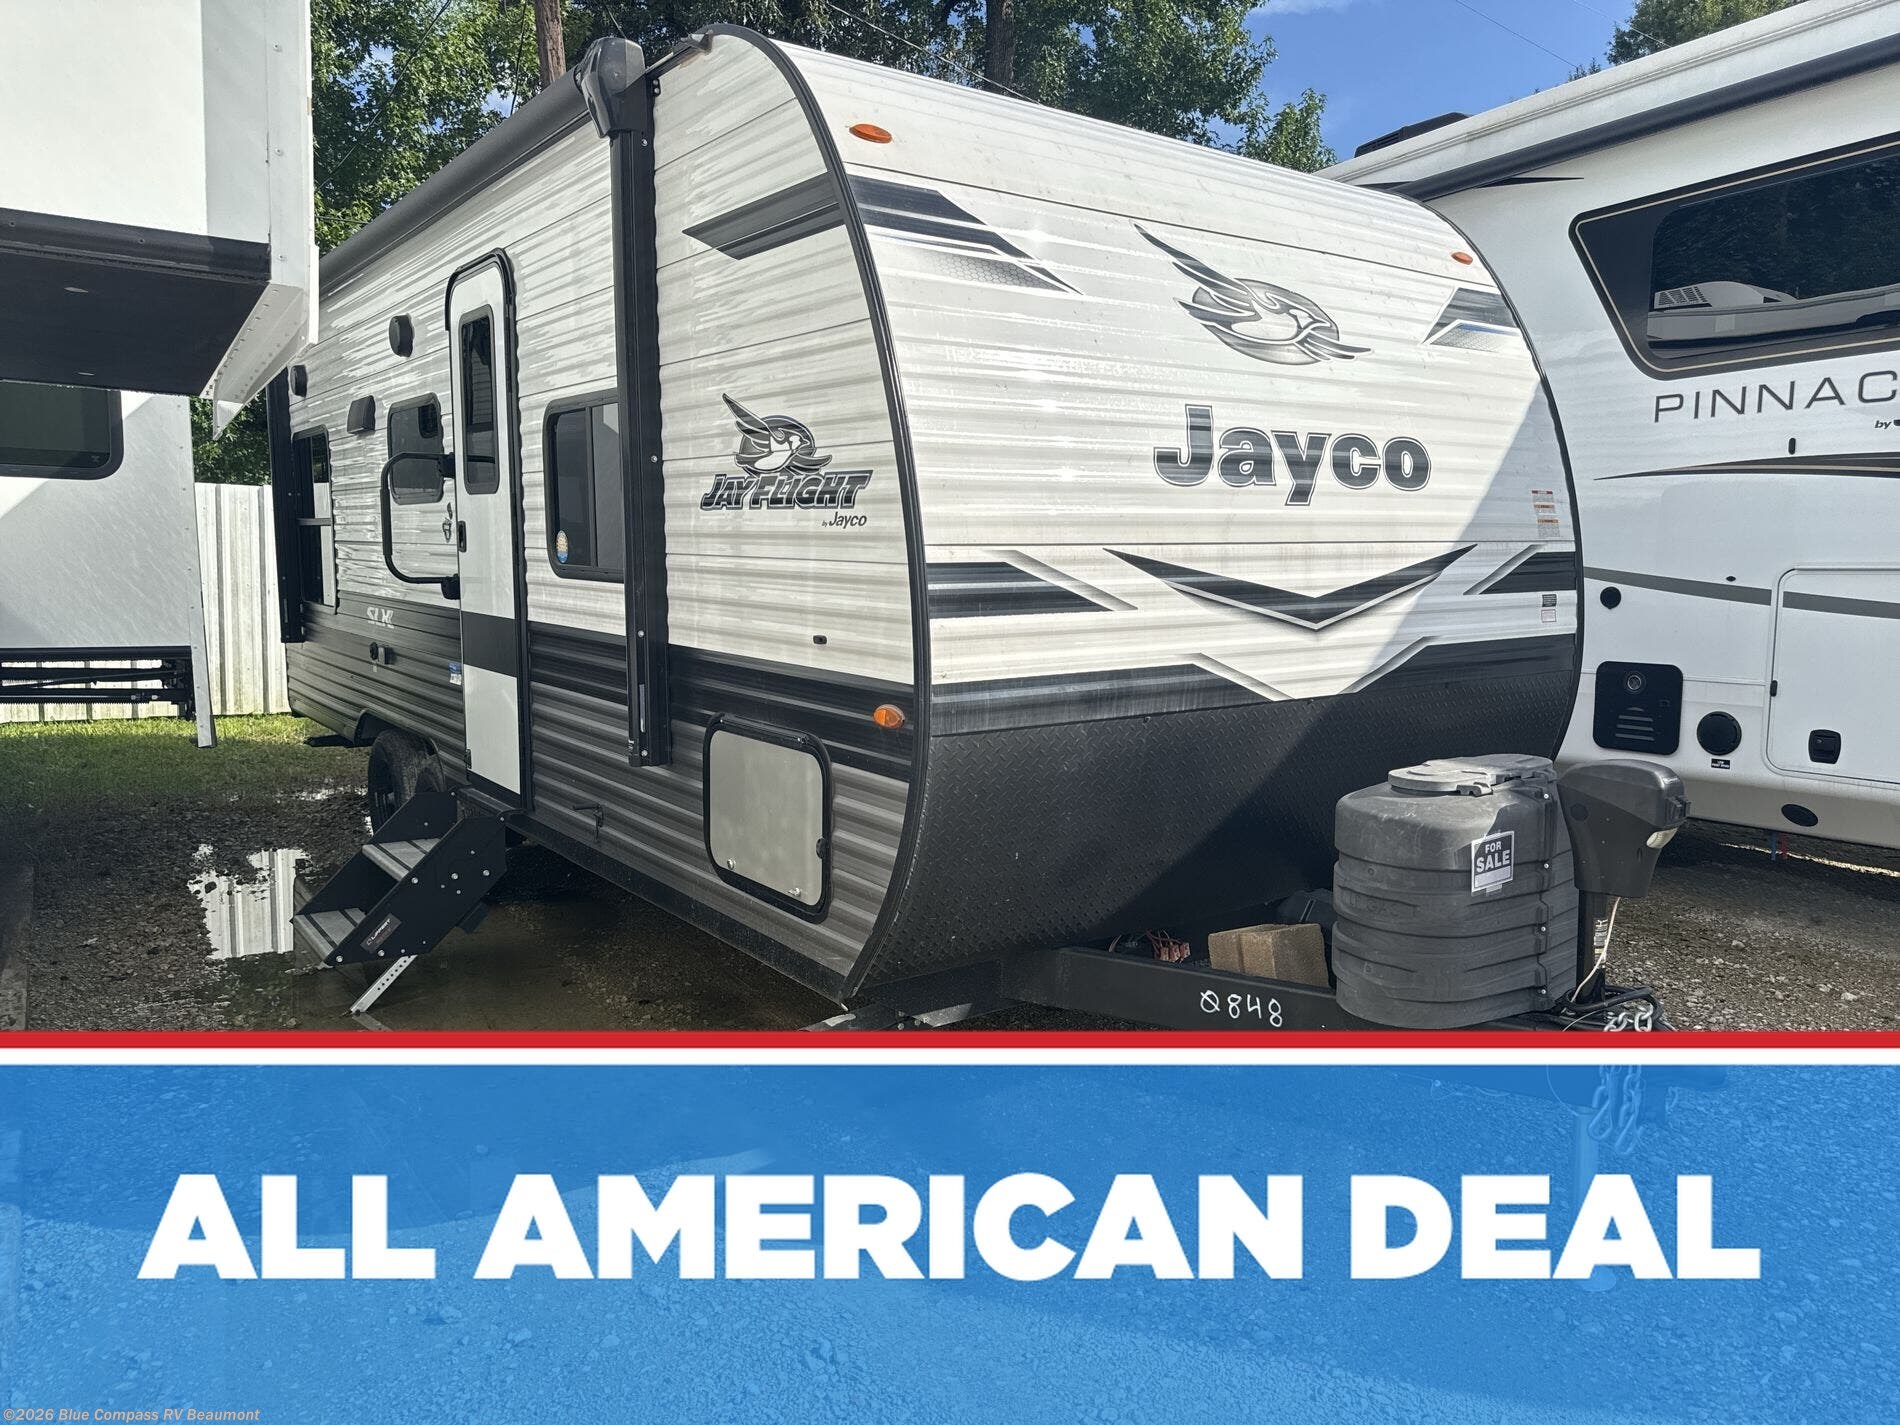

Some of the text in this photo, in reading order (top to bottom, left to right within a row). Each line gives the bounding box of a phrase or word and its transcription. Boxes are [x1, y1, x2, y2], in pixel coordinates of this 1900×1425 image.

[1654, 370, 1898, 423] PINNAC
[1874, 420, 1892, 430] by
[1153, 404, 1431, 507] Jayco
[700, 469, 874, 511] JAY FLIGHT
[828, 511, 867, 529] Jayco
[1485, 841, 1502, 854] FOR
[1476, 849, 1511, 873] SALE
